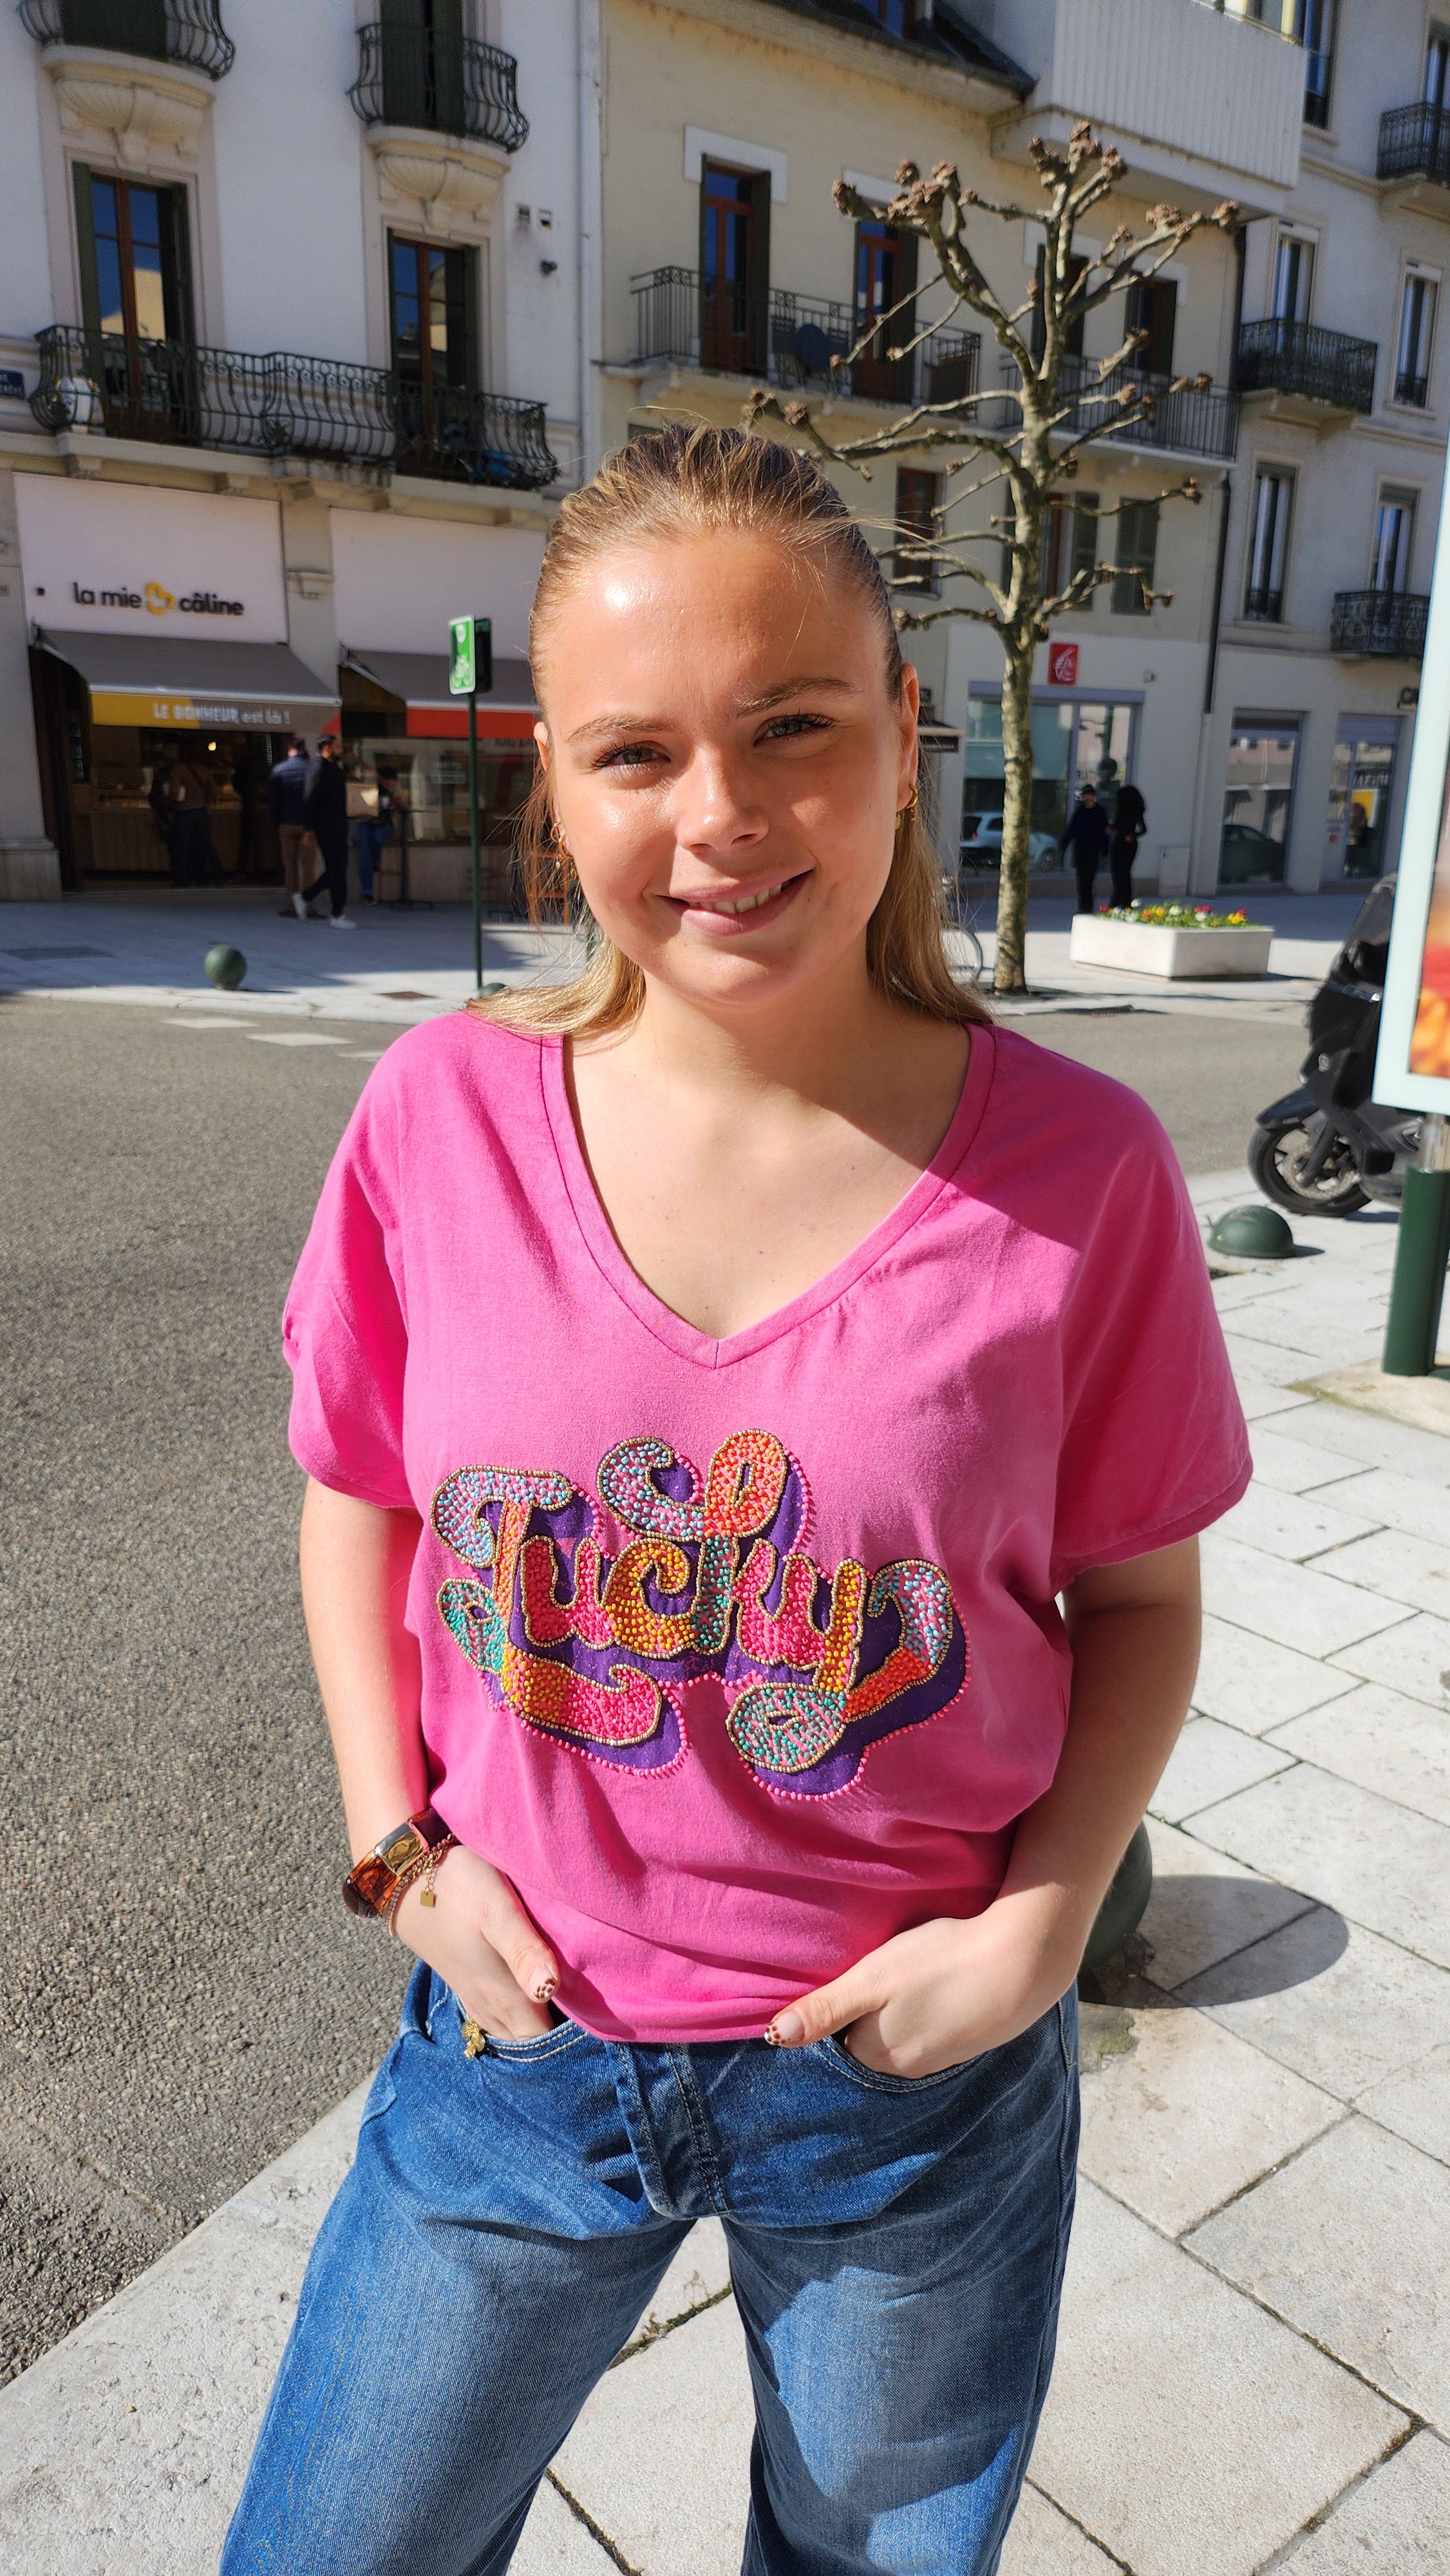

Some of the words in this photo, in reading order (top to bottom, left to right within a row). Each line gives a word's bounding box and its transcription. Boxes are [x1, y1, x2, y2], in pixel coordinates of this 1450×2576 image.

[73, 582, 95, 605] la
[100, 587, 142, 609] mie
[178, 591, 244, 616] câline
[153, 700, 169, 719] LE
[173, 704, 239, 724] BONHEUR
[429, 1428, 954, 1775] Lucky
